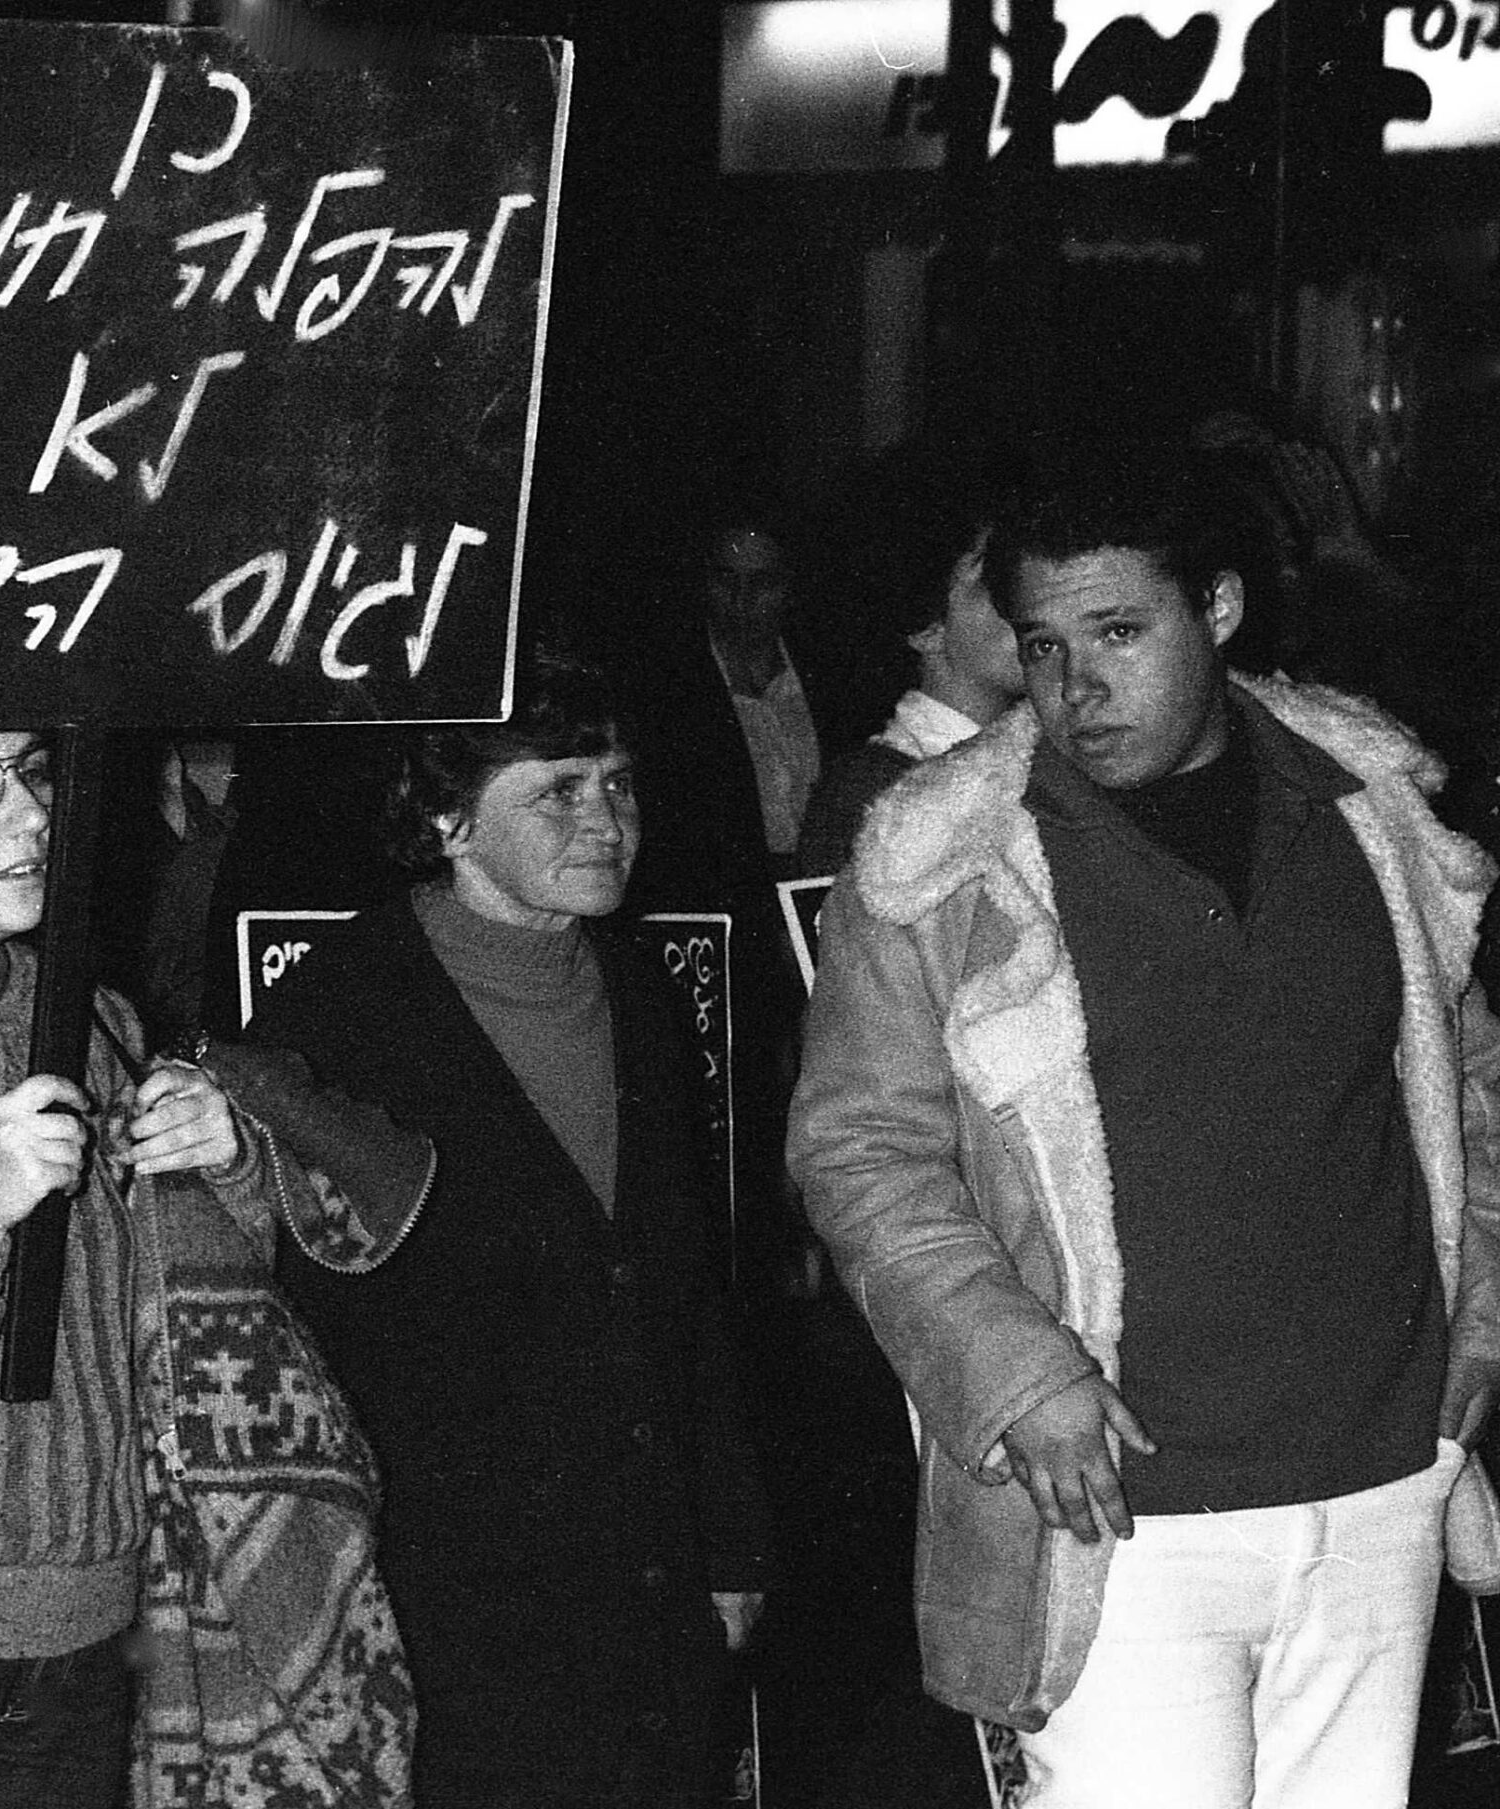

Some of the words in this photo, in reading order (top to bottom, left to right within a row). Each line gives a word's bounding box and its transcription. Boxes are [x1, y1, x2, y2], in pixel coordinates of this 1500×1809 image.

[111, 63, 252, 200] כן
[173, 168, 536, 342] להפלה
[29, 352, 245, 500] לא
[192, 518, 488, 680] לגיוס
